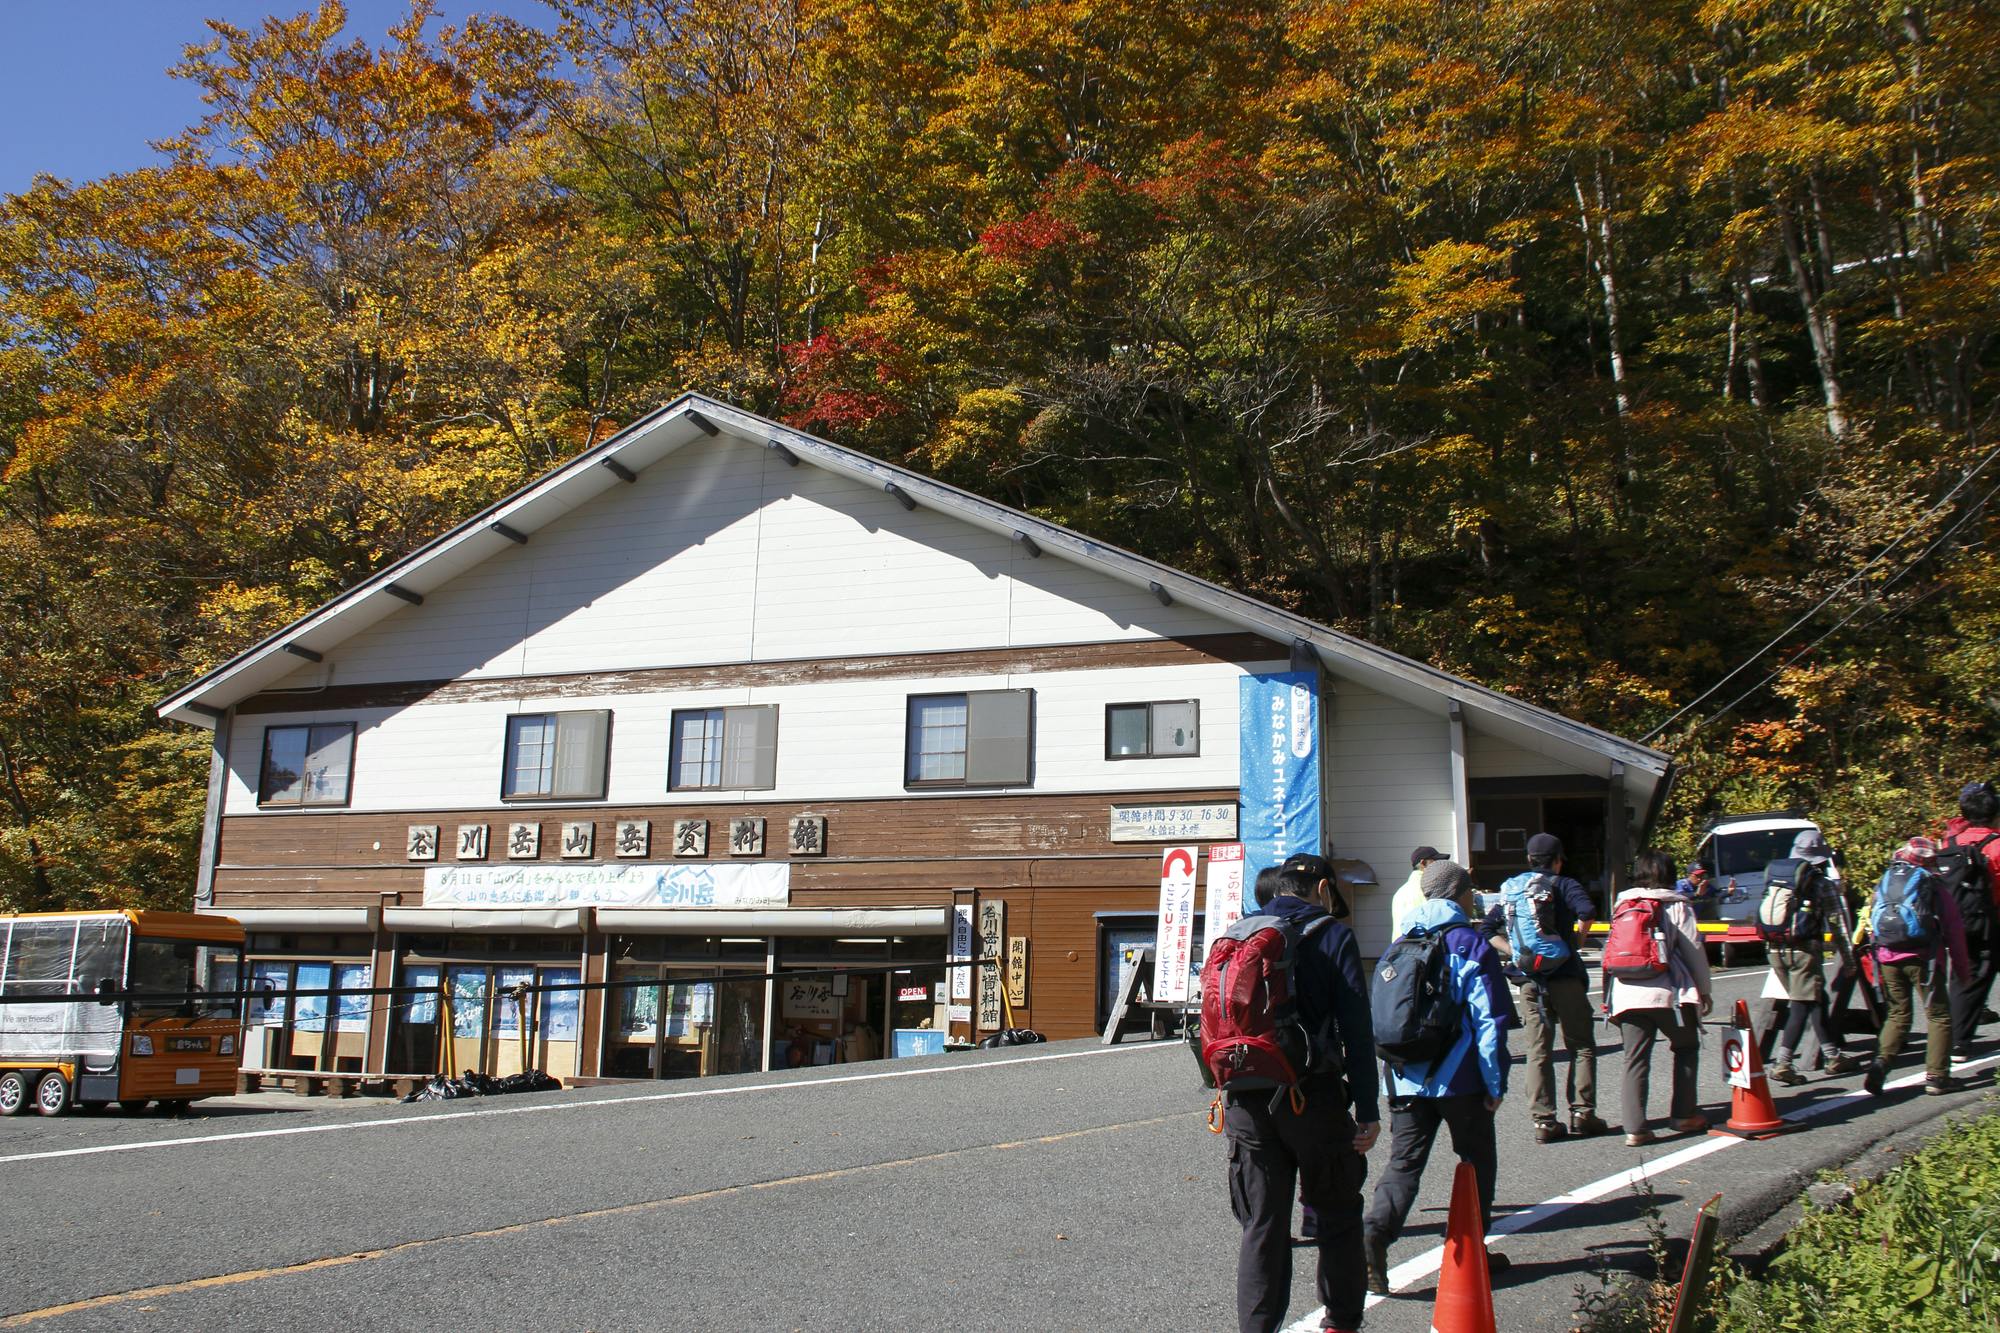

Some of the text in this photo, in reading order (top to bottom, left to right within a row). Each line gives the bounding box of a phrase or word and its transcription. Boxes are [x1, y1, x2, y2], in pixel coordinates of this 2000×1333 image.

[407, 818, 819, 857] 谷川岳山岳資料館
[661, 881, 714, 905] 谷川岳
[1226, 871, 1241, 932] この先、車
[1011, 940, 1024, 985] 開館中
[900, 987, 924, 996] OPEN
[1009, 989, 1024, 997] 入口
